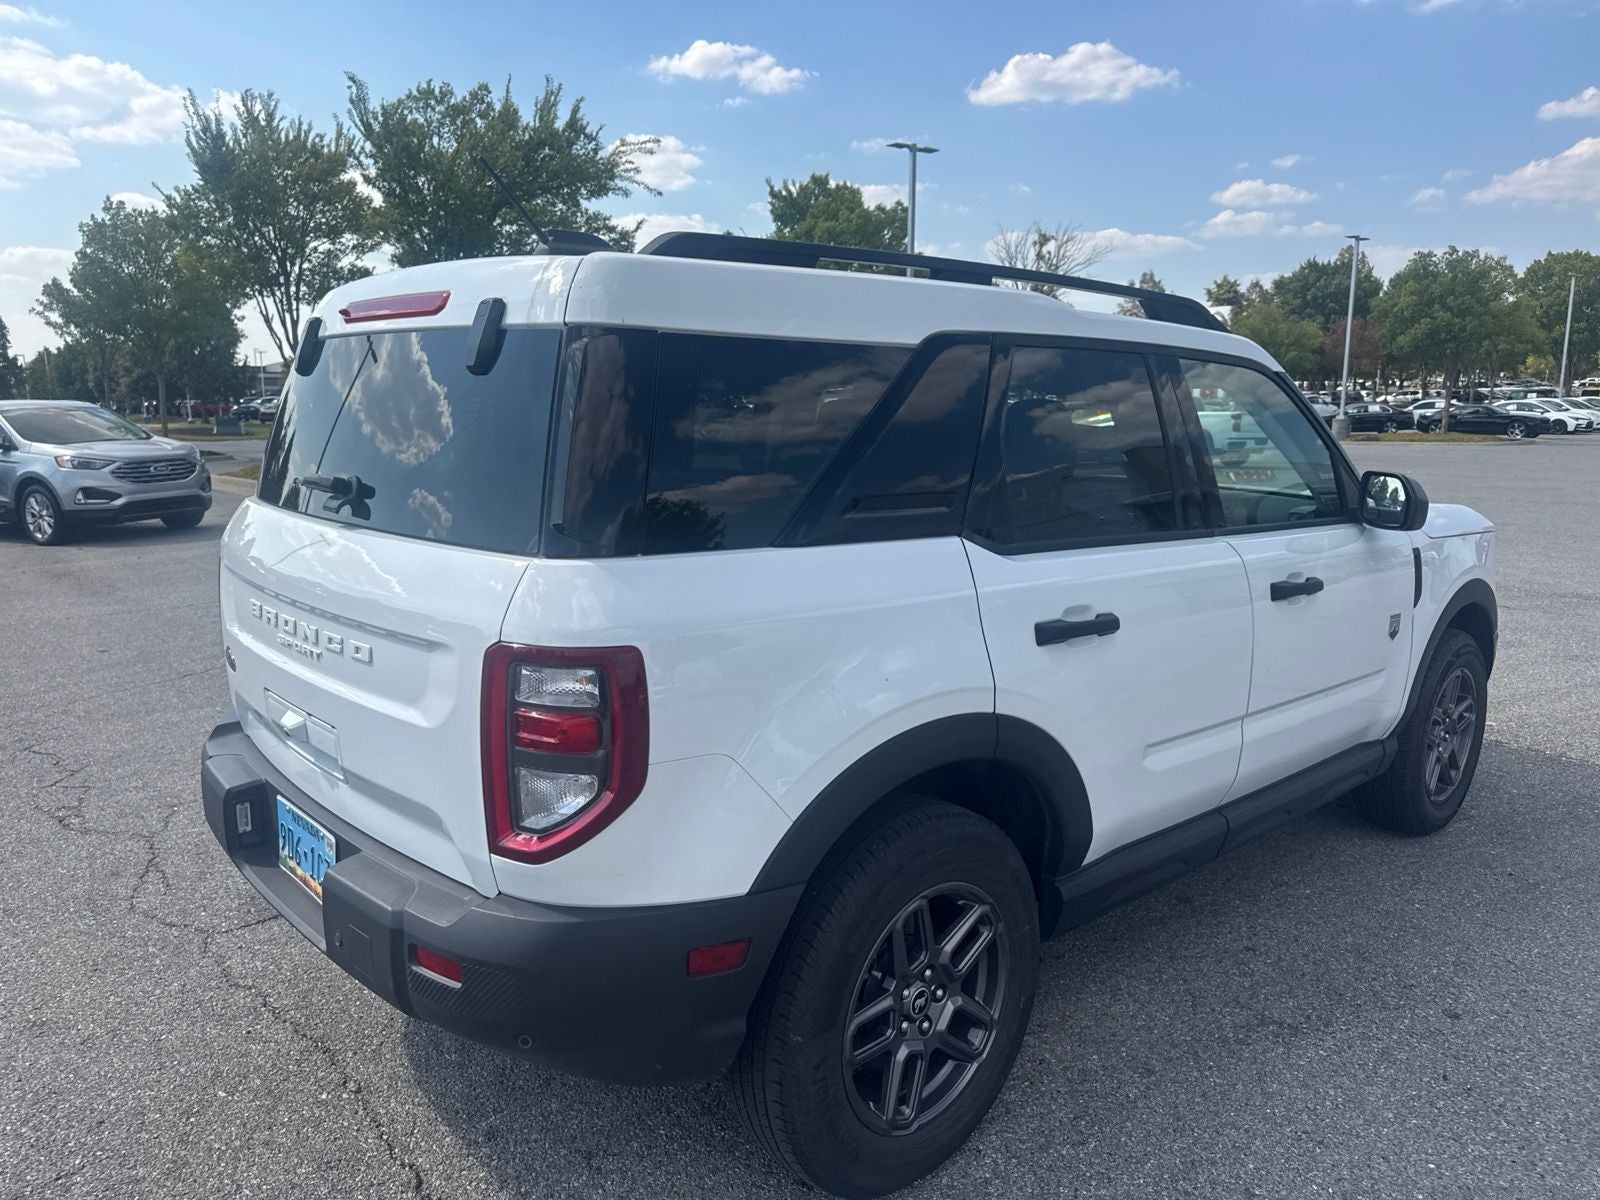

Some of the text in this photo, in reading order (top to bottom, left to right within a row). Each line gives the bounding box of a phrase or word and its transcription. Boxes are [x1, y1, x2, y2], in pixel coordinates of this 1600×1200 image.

[250, 598, 373, 664] BRONCO
[277, 633, 323, 662] SPORT
[291, 811, 320, 842] NEVADA
